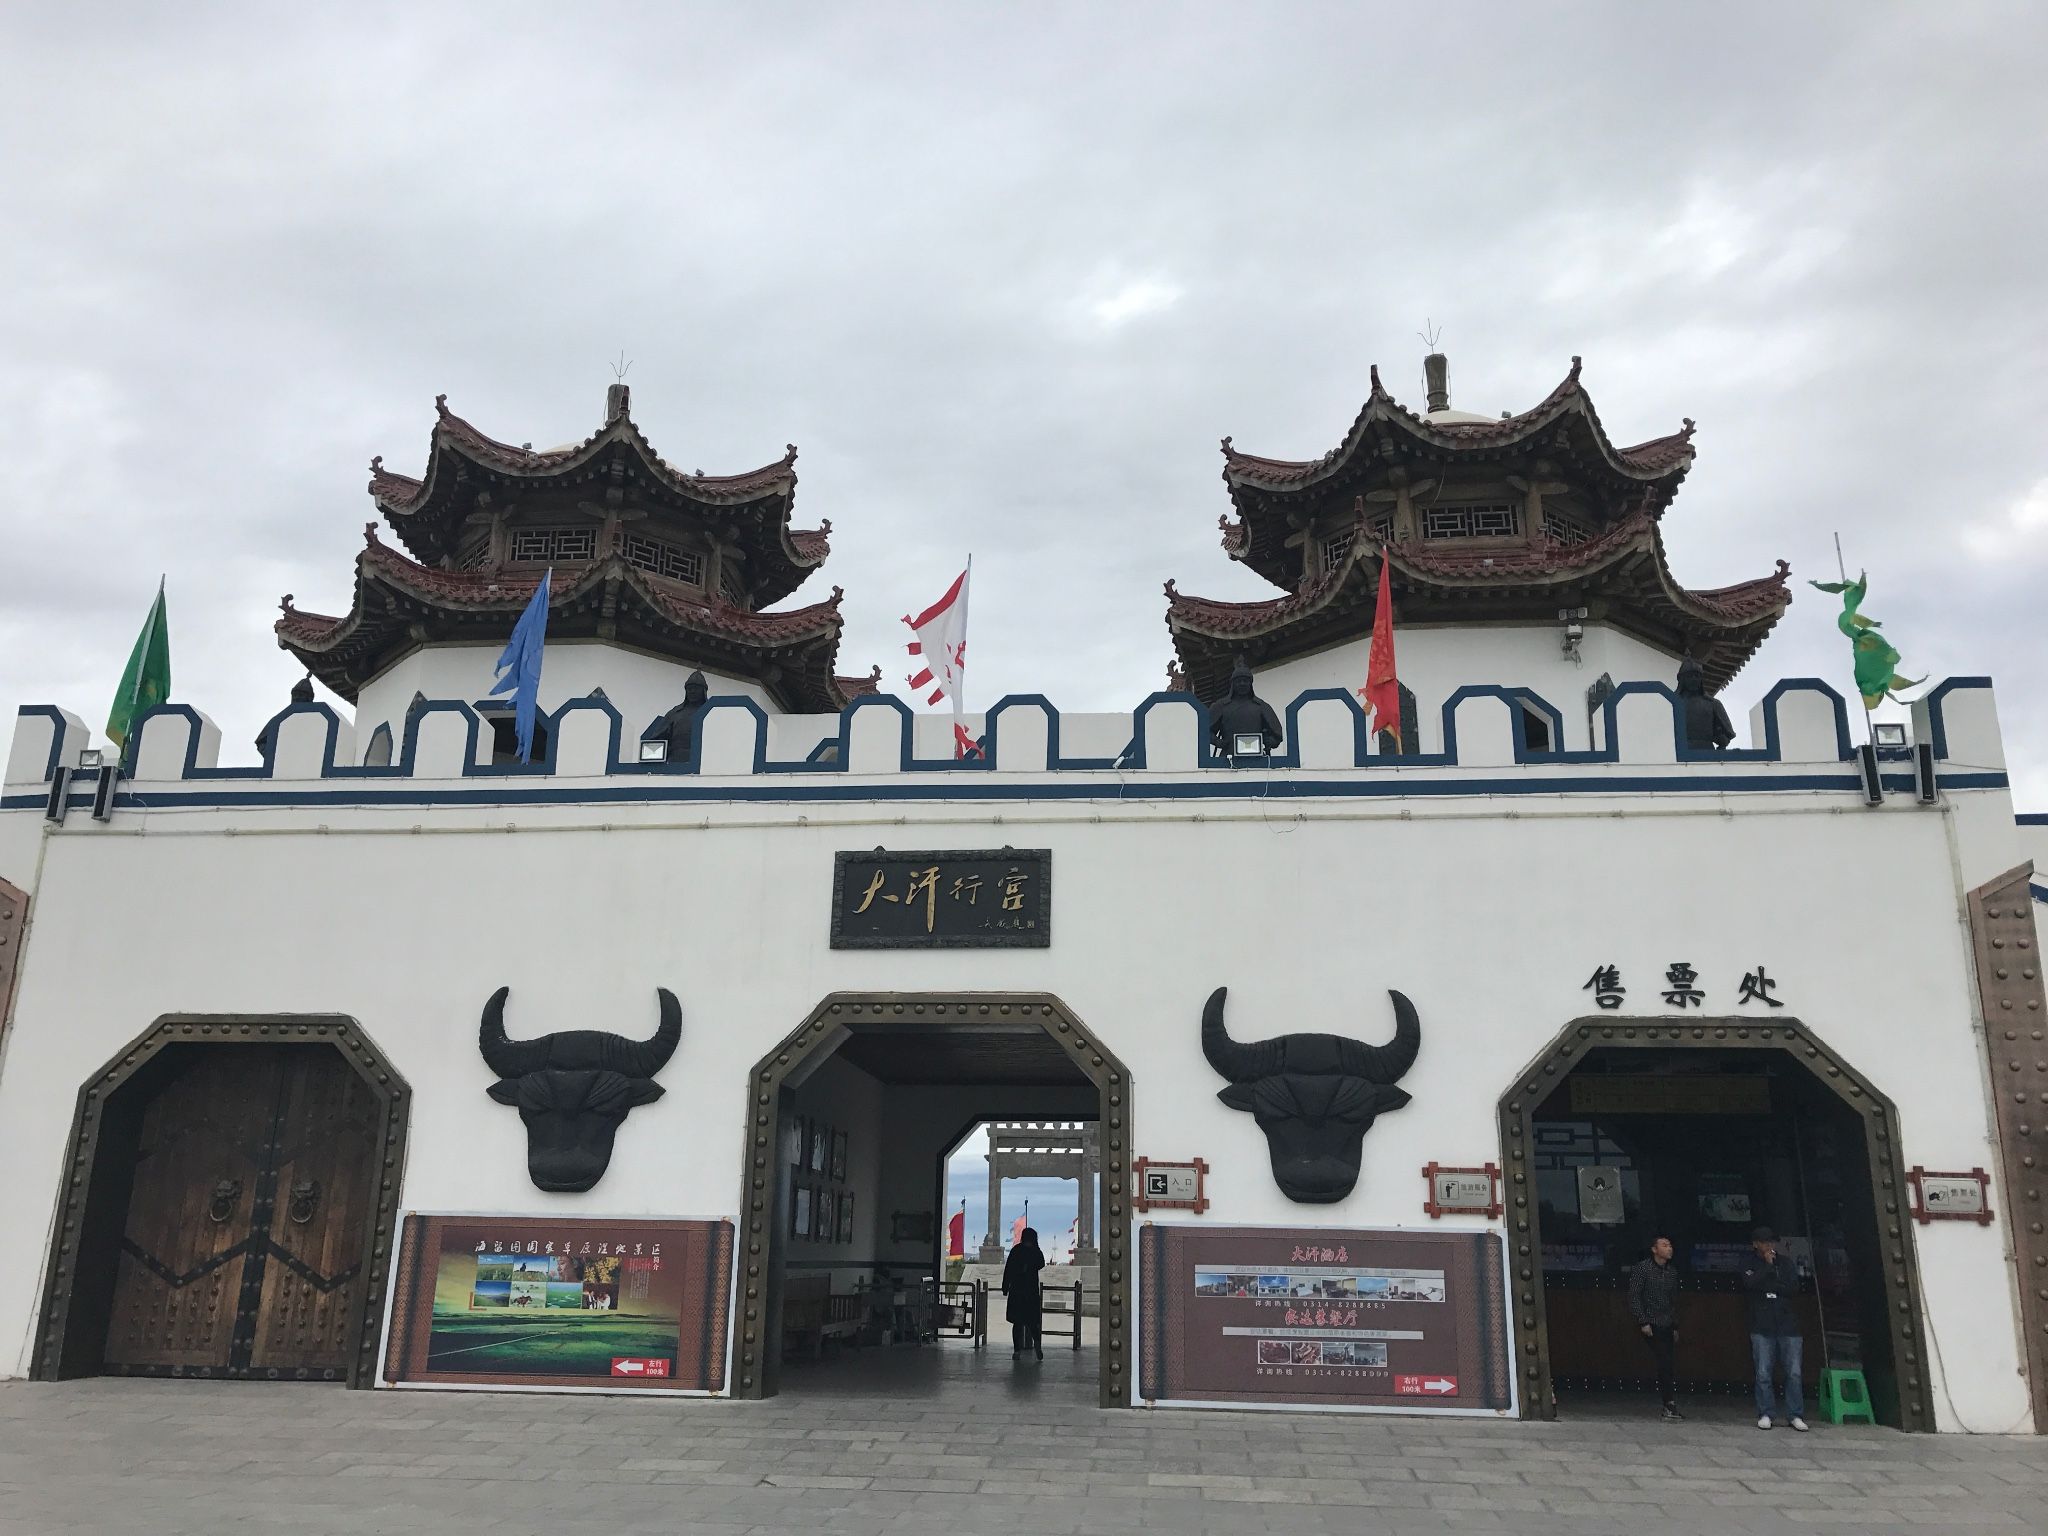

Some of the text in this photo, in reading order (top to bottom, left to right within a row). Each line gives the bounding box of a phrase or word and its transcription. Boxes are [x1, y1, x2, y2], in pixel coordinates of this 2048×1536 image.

[852, 866, 1029, 933] 大汗行宫
[1582, 962, 1784, 1009] 售票处
[1172, 1178, 1191, 1186] 入口
[1291, 1245, 1349, 1263] 大汗酒店
[652, 1256, 660, 1270] 简介
[648, 1359, 663, 1368] 左行
[646, 1368, 664, 1376] 100米
[1403, 1376, 1418, 1385] 右行
[1402, 1385, 1421, 1394] 100米
